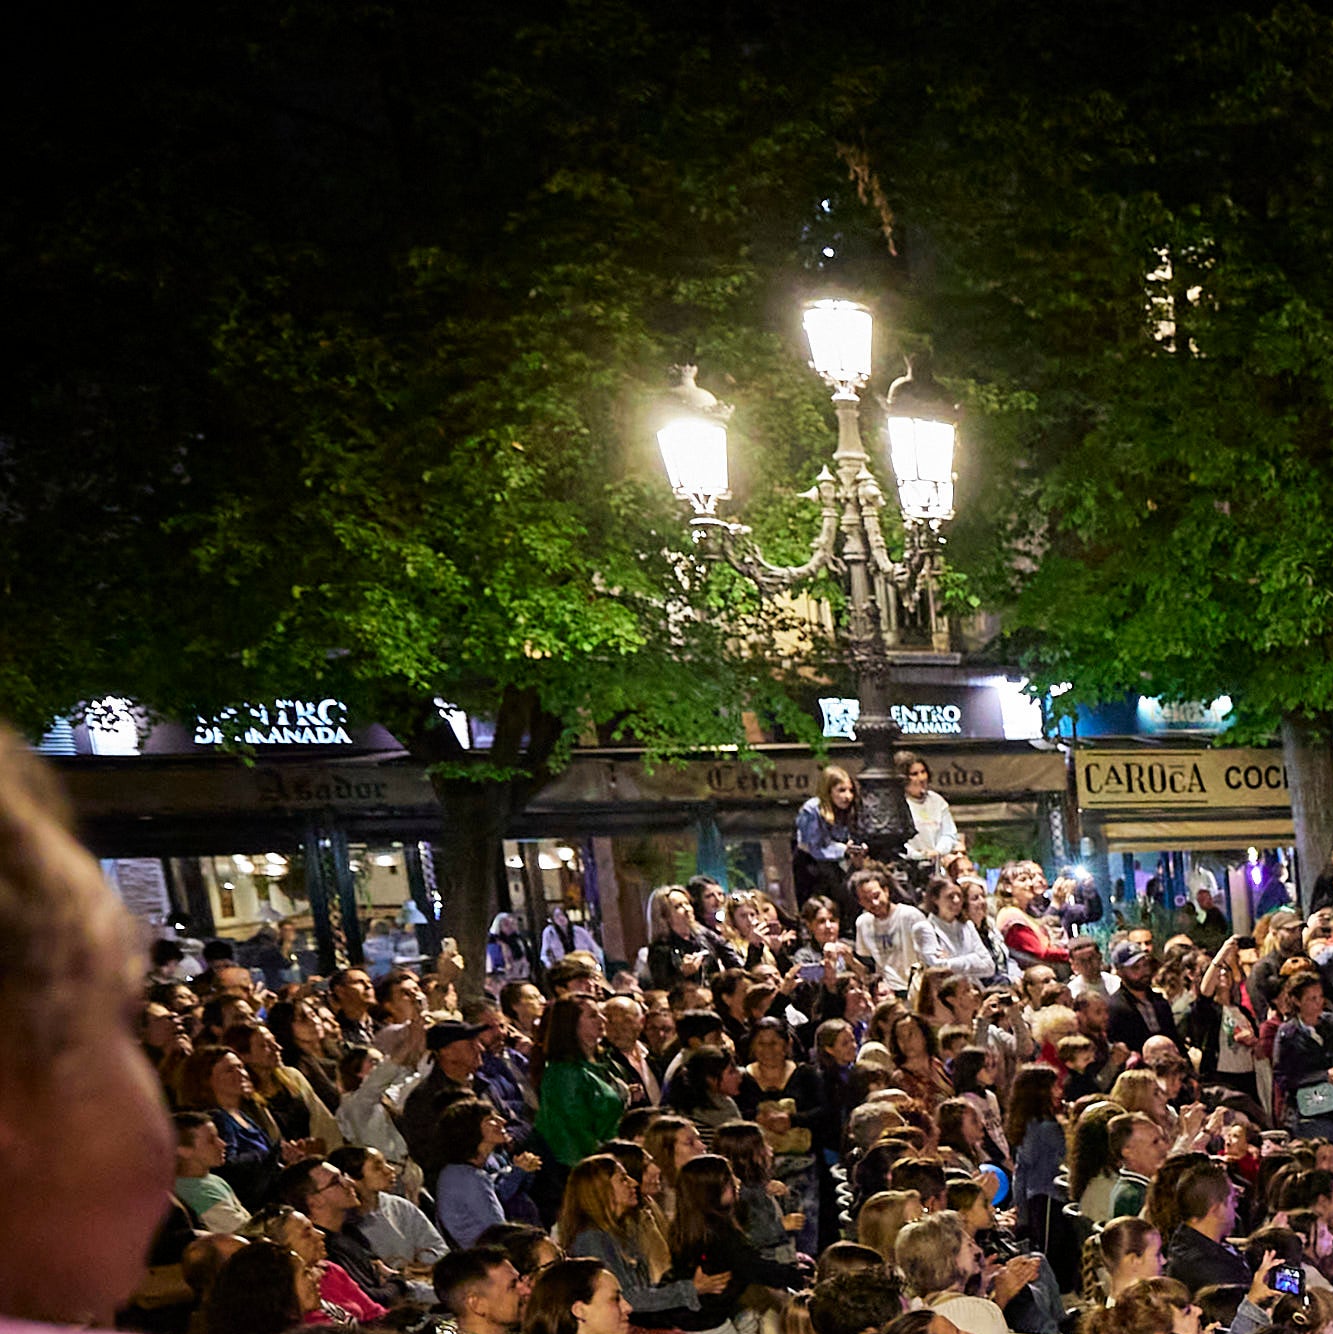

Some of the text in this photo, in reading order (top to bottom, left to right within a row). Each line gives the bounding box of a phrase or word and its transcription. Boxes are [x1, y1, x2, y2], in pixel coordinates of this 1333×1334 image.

[890, 704, 961, 722] ENTRO
[706, 762, 809, 793] Centro
[1084, 762, 1207, 795] CAROCA
